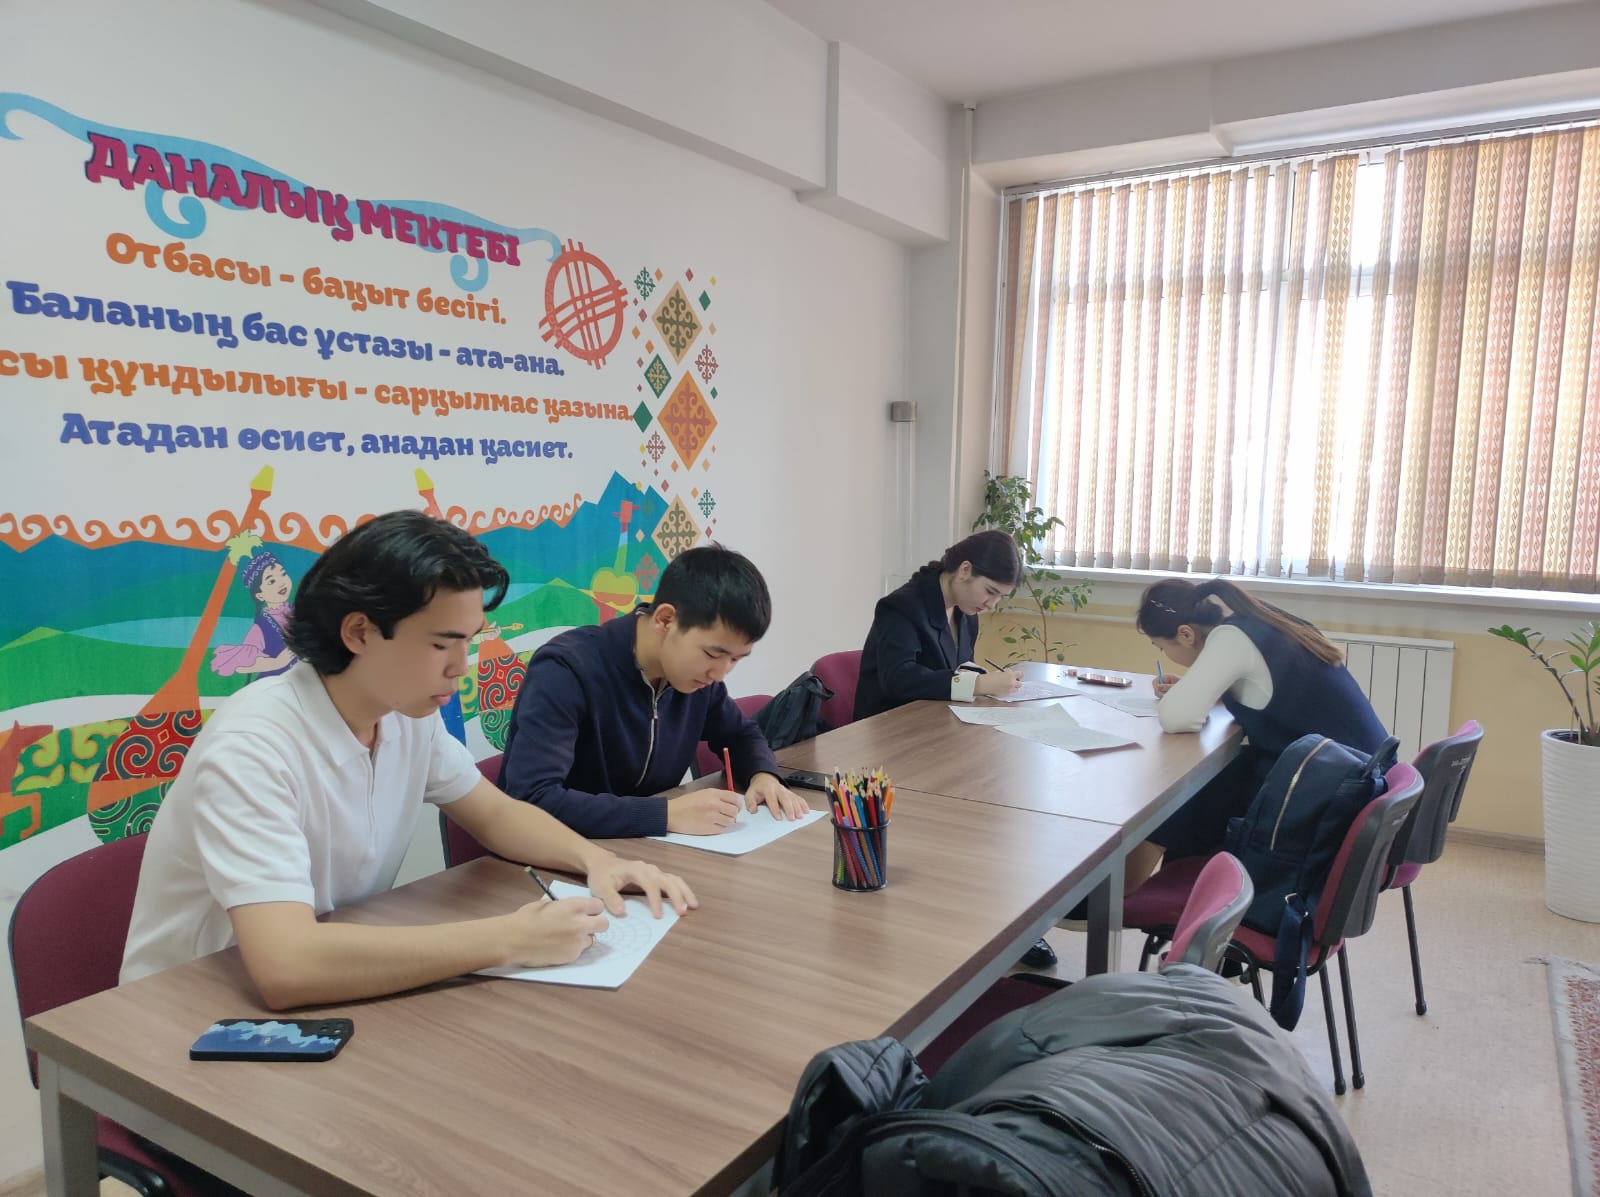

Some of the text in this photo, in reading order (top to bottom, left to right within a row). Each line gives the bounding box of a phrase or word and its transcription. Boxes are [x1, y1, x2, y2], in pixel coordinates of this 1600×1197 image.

[85, 131, 521, 267] ДАНАЛЫҚ МЕКТЕБІ
[105, 232, 272, 287] Отбасы
[302, 267, 411, 312] бақыт
[416, 287, 507, 325] бесігі.
[5, 280, 239, 349] Баланың
[241, 311, 308, 347] бас
[314, 327, 433, 362] ұстазы
[456, 346, 565, 376] ата-ана.
[78, 357, 348, 401] құндылығы
[373, 383, 539, 417] сарқылмас
[542, 398, 633, 424] қазына.
[59, 413, 573, 465] Атадан өсиет, анадан қасиет.
